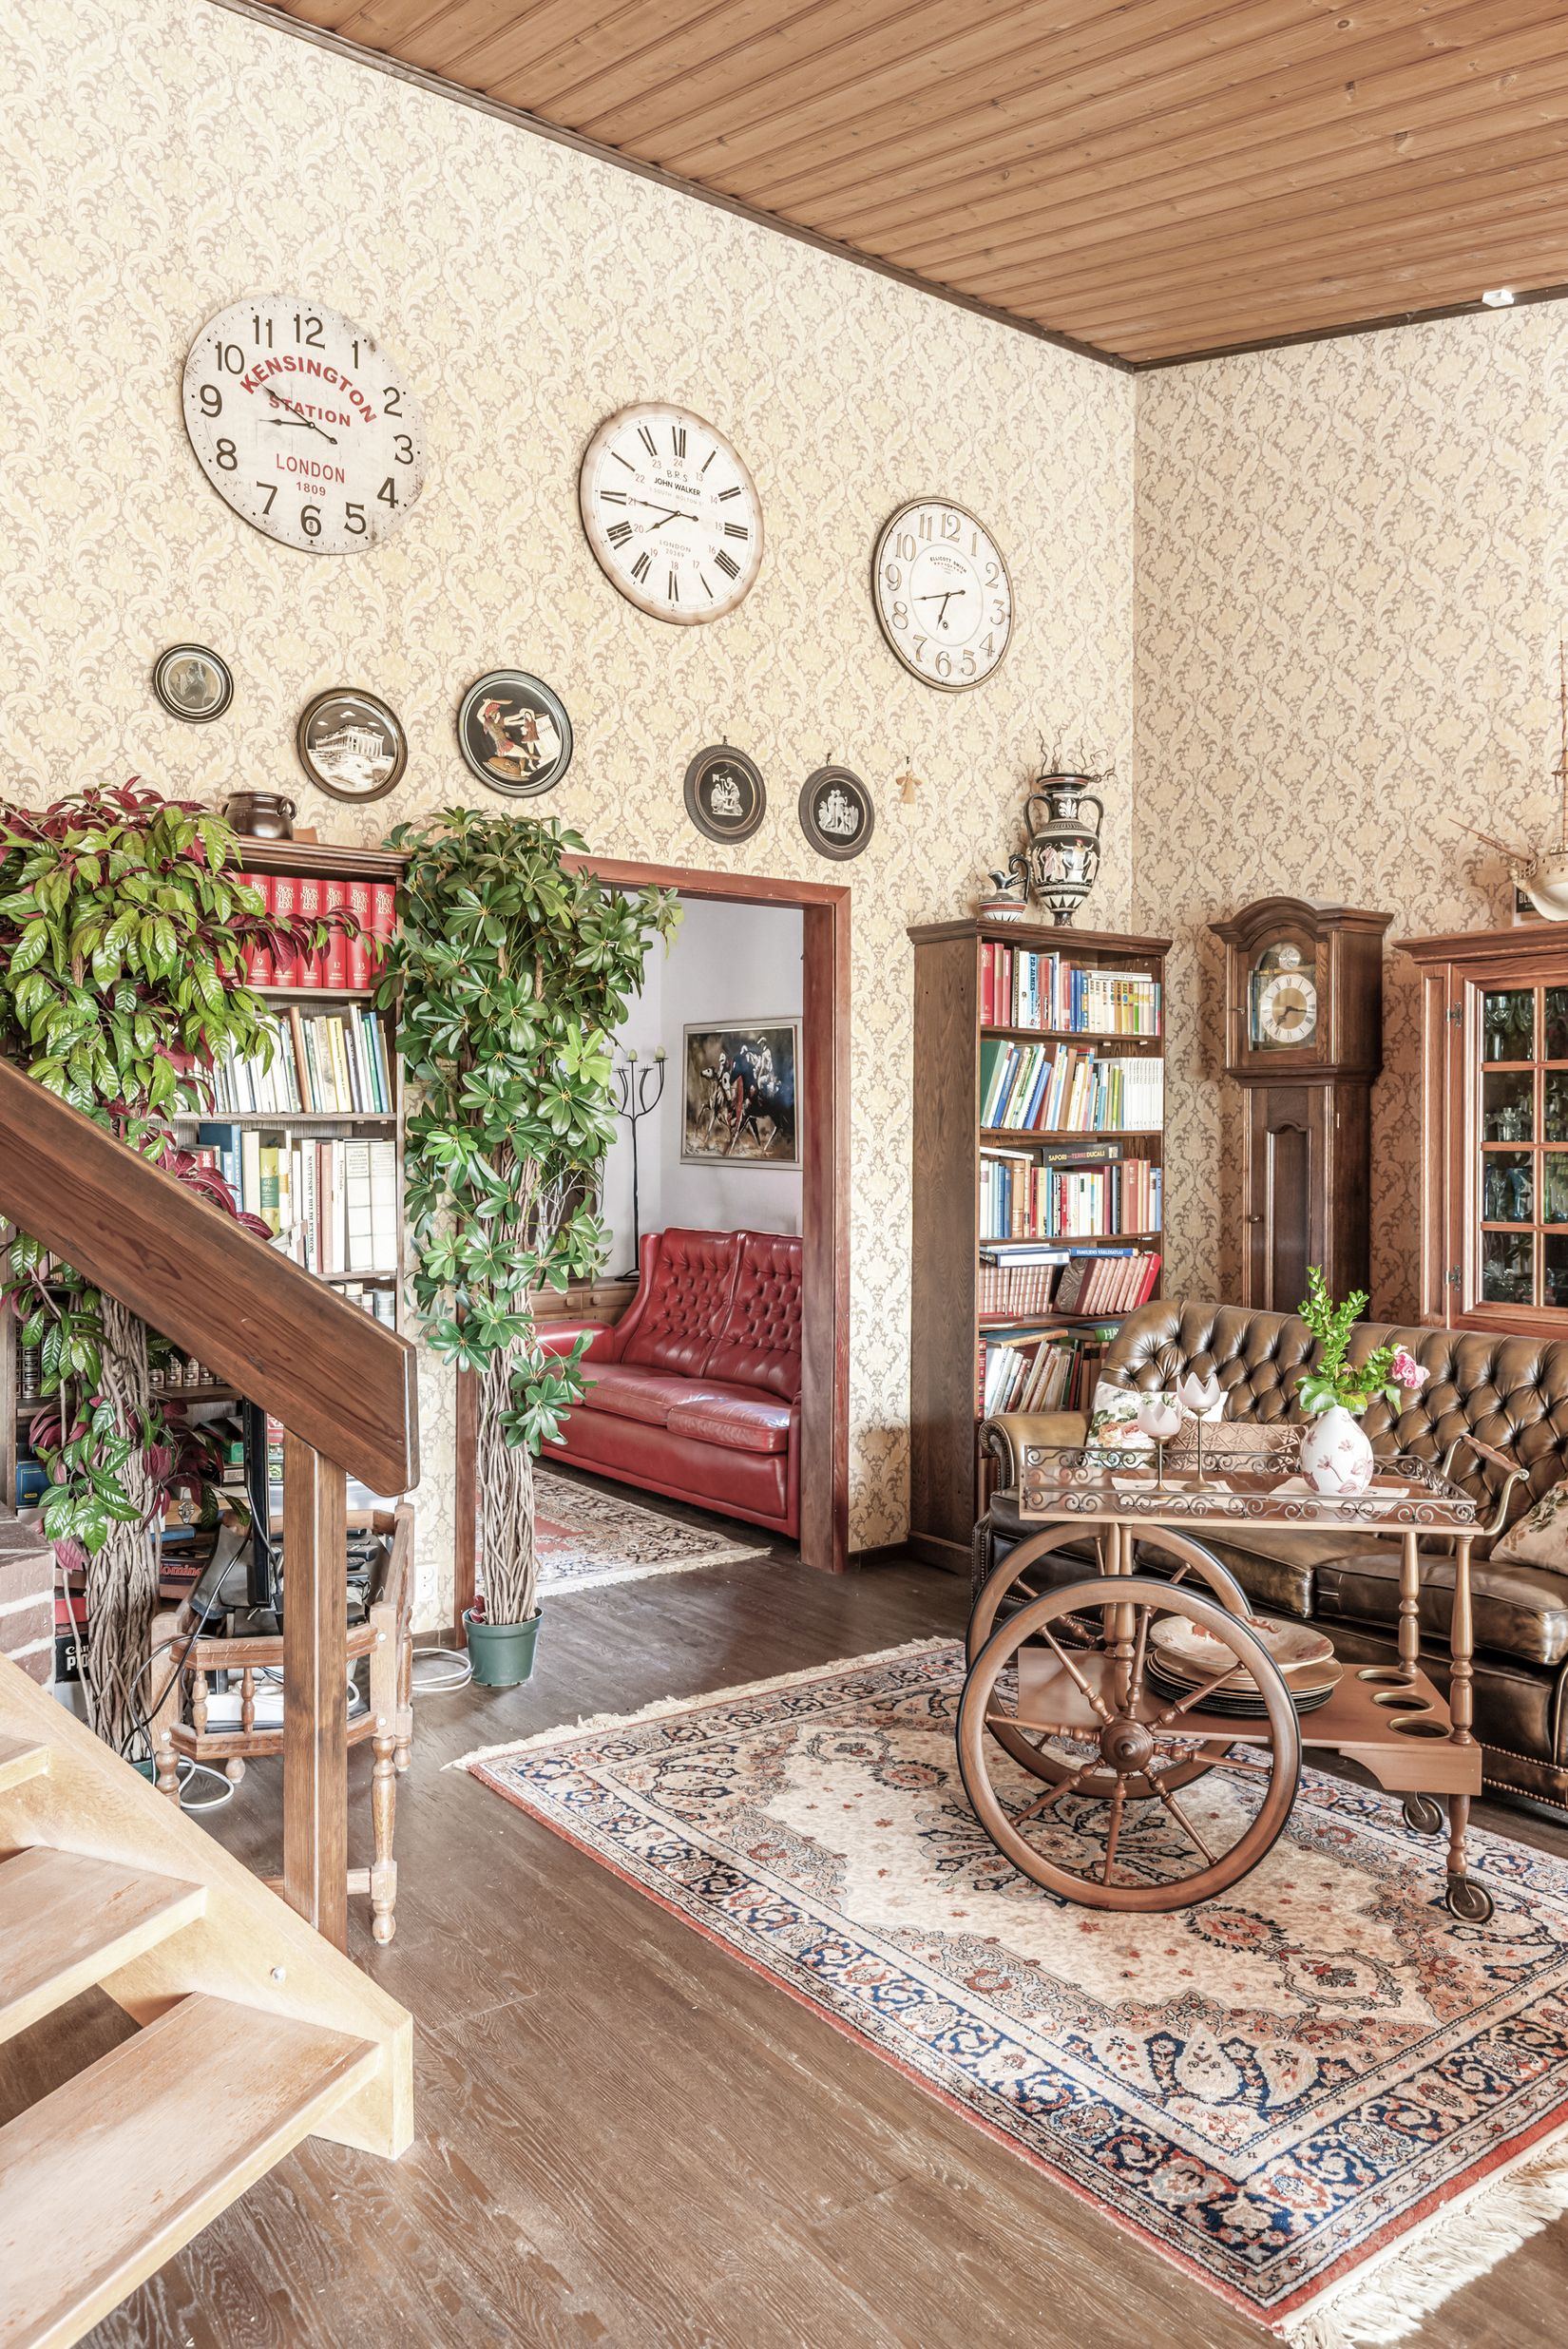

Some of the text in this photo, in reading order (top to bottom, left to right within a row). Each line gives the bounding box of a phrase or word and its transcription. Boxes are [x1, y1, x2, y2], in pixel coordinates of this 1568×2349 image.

[253, 315, 273, 349] 11
[294, 314, 326, 350] 12
[215, 340, 245, 375] 10
[352, 340, 359, 370] 1
[200, 384, 223, 418] 9
[239, 355, 377, 423] KENSINGTON
[383, 386, 403, 418] 2
[269, 395, 351, 427] STATION
[216, 438, 238, 471] 8
[392, 433, 414, 466] 3
[276, 453, 345, 484] LONDON
[256, 481, 277, 515] 7
[296, 481, 326, 496] 1809
[377, 477, 399, 509] 4
[654, 477, 674, 488] JOHN
[674, 483, 701, 496] WALKER
[300, 505, 322, 537] 6
[344, 502, 367, 535] 5
[918, 513, 932, 541] 11
[940, 513, 961, 543] 12
[660, 540, 691, 553] LONDON
[895, 532, 916, 562] 10
[971, 532, 977, 557] 1
[671, 561, 679, 570] 18
[693, 560, 700, 569] 17
[885, 563, 902, 591] 9
[985, 562, 999, 589] 2
[891, 601, 908, 630] 8
[990, 600, 1004, 625] 3
[912, 635, 928, 662] 7
[979, 632, 996, 658] 4
[935, 651, 952, 678] 6
[960, 649, 976, 677] 5
[258, 958, 263, 966] 9
[334, 961, 341, 969] 12
[1048, 1154, 1067, 1162] SAPORI
[1086, 1150, 1105, 1158] DUCALI
